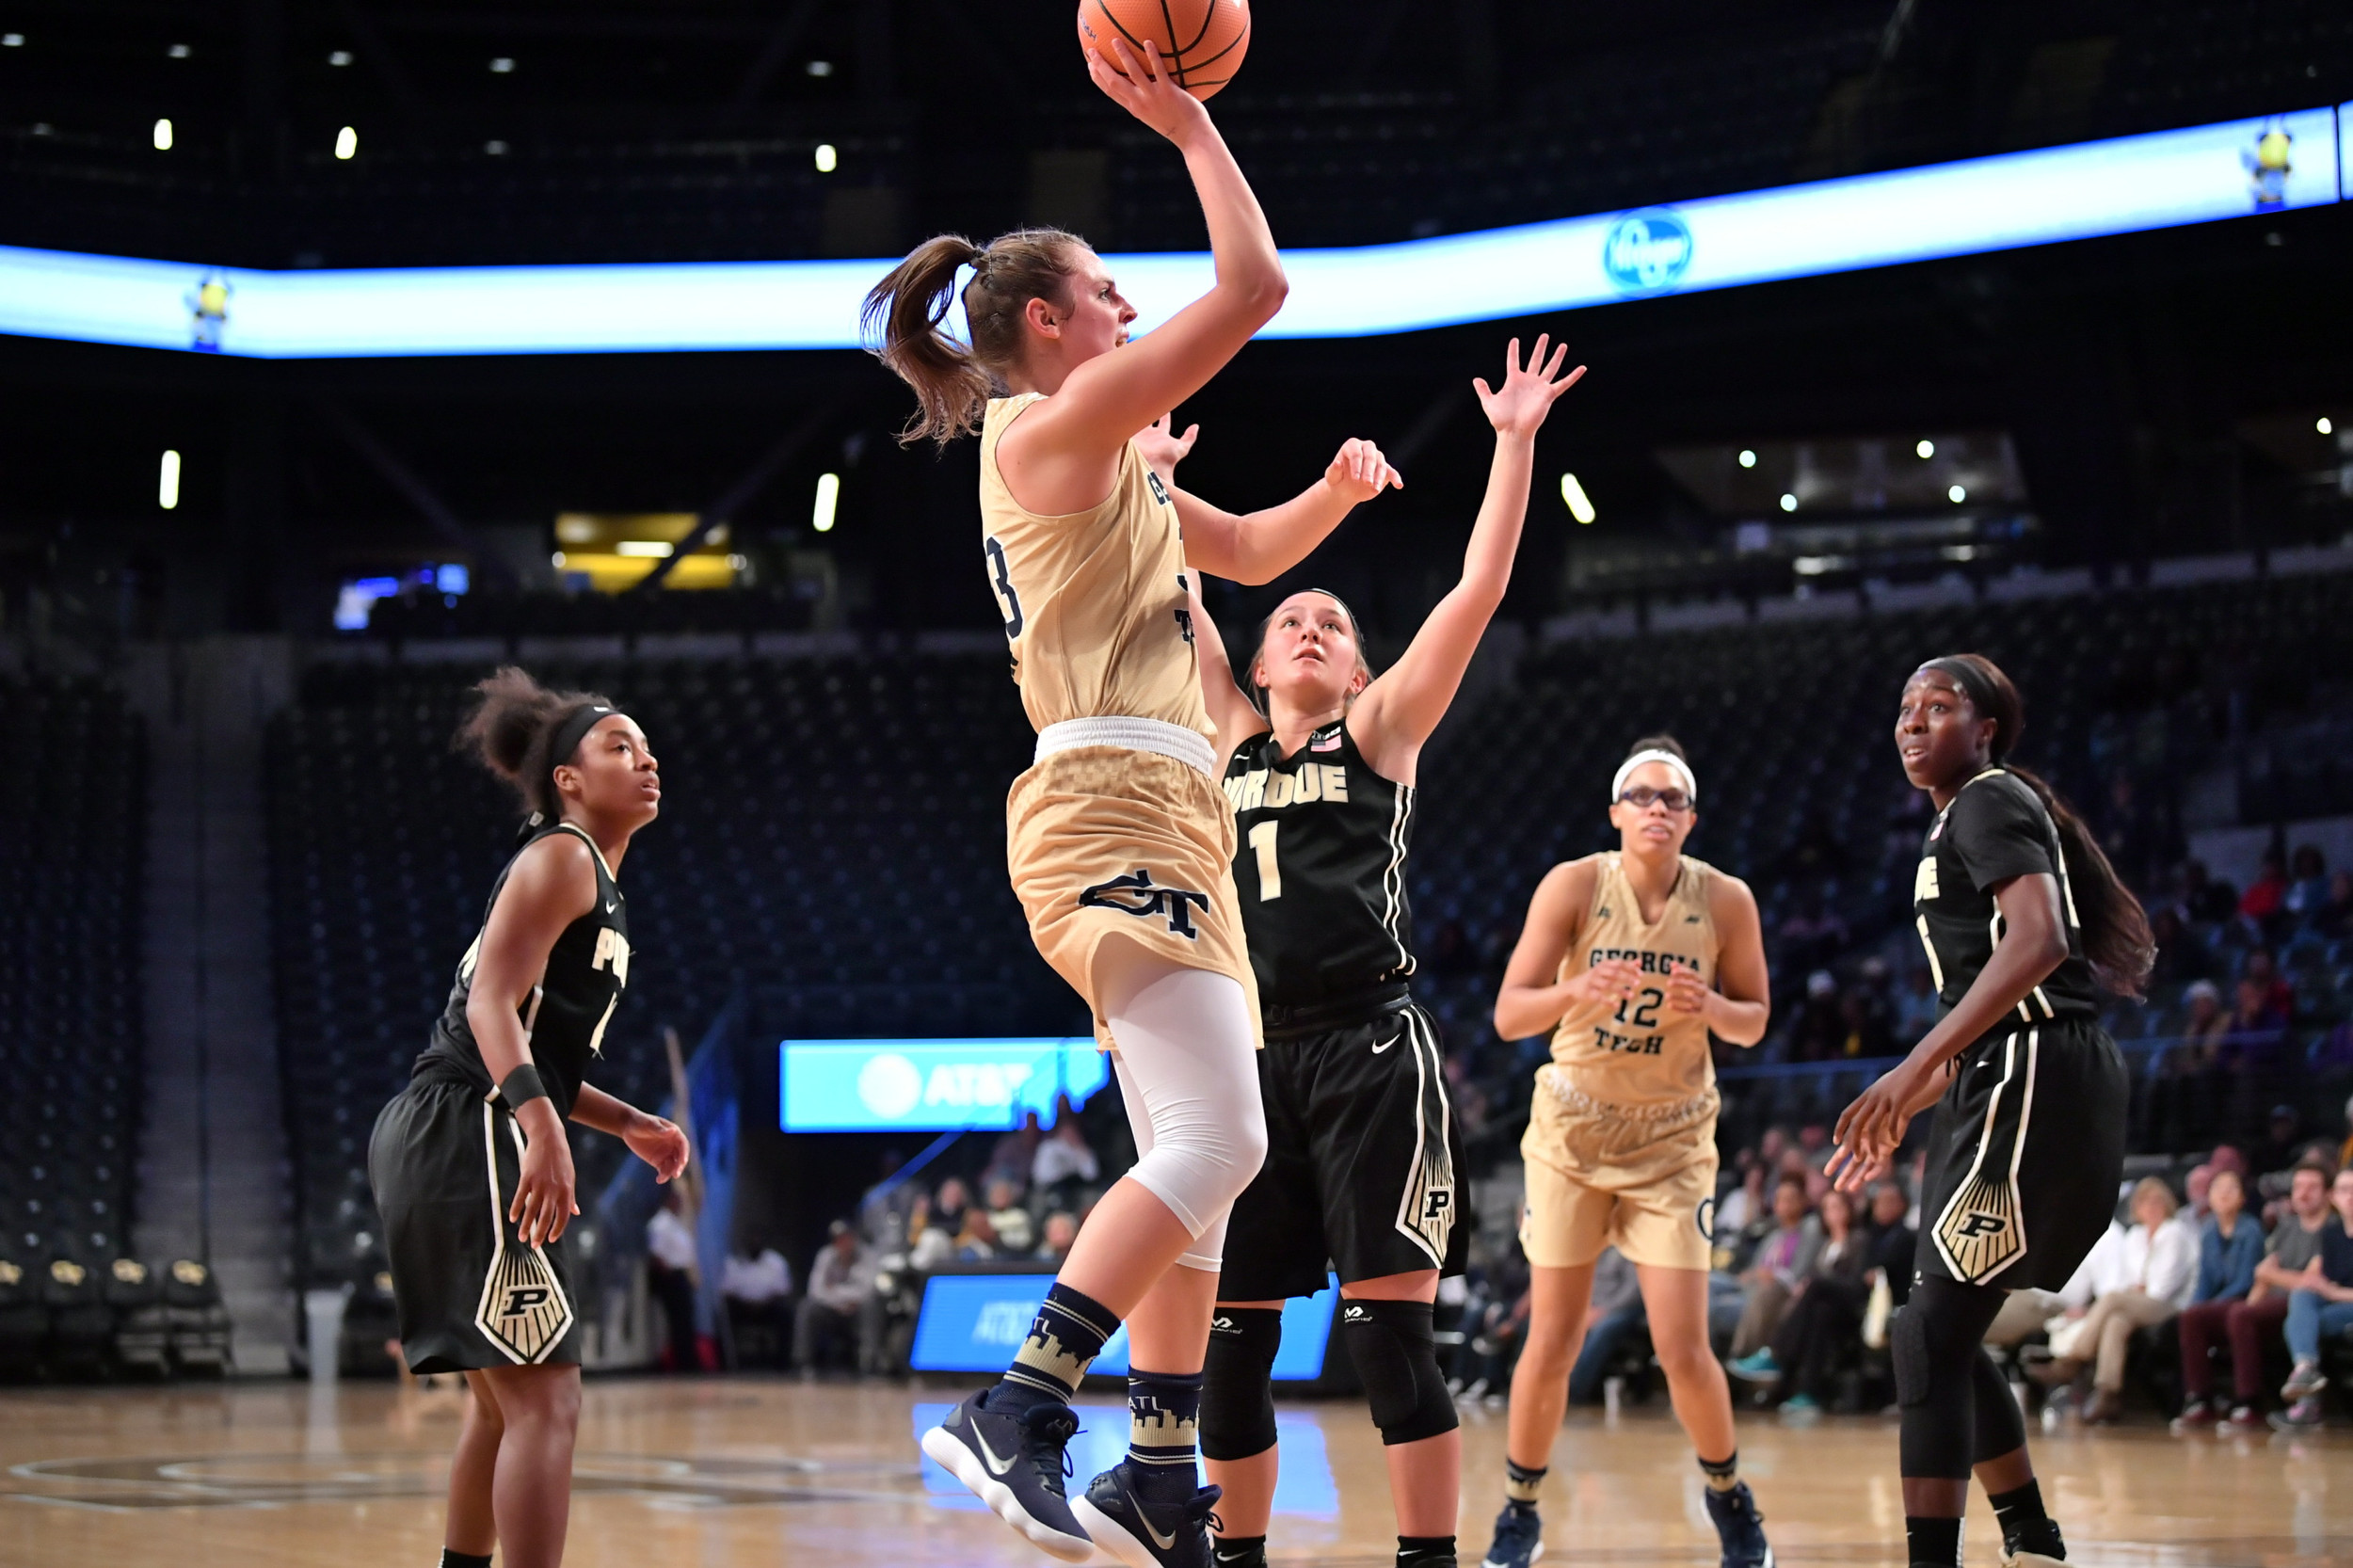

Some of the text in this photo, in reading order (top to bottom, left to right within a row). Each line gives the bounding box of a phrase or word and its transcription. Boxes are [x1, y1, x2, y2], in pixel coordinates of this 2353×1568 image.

[1248, 819, 1283, 903] 1
[1079, 869, 1209, 940] GT
[1424, 1191, 1450, 1218] P
[1958, 1213, 2007, 1239] P
[502, 1288, 549, 1316] P
[1128, 1396, 1167, 1412] ATL
